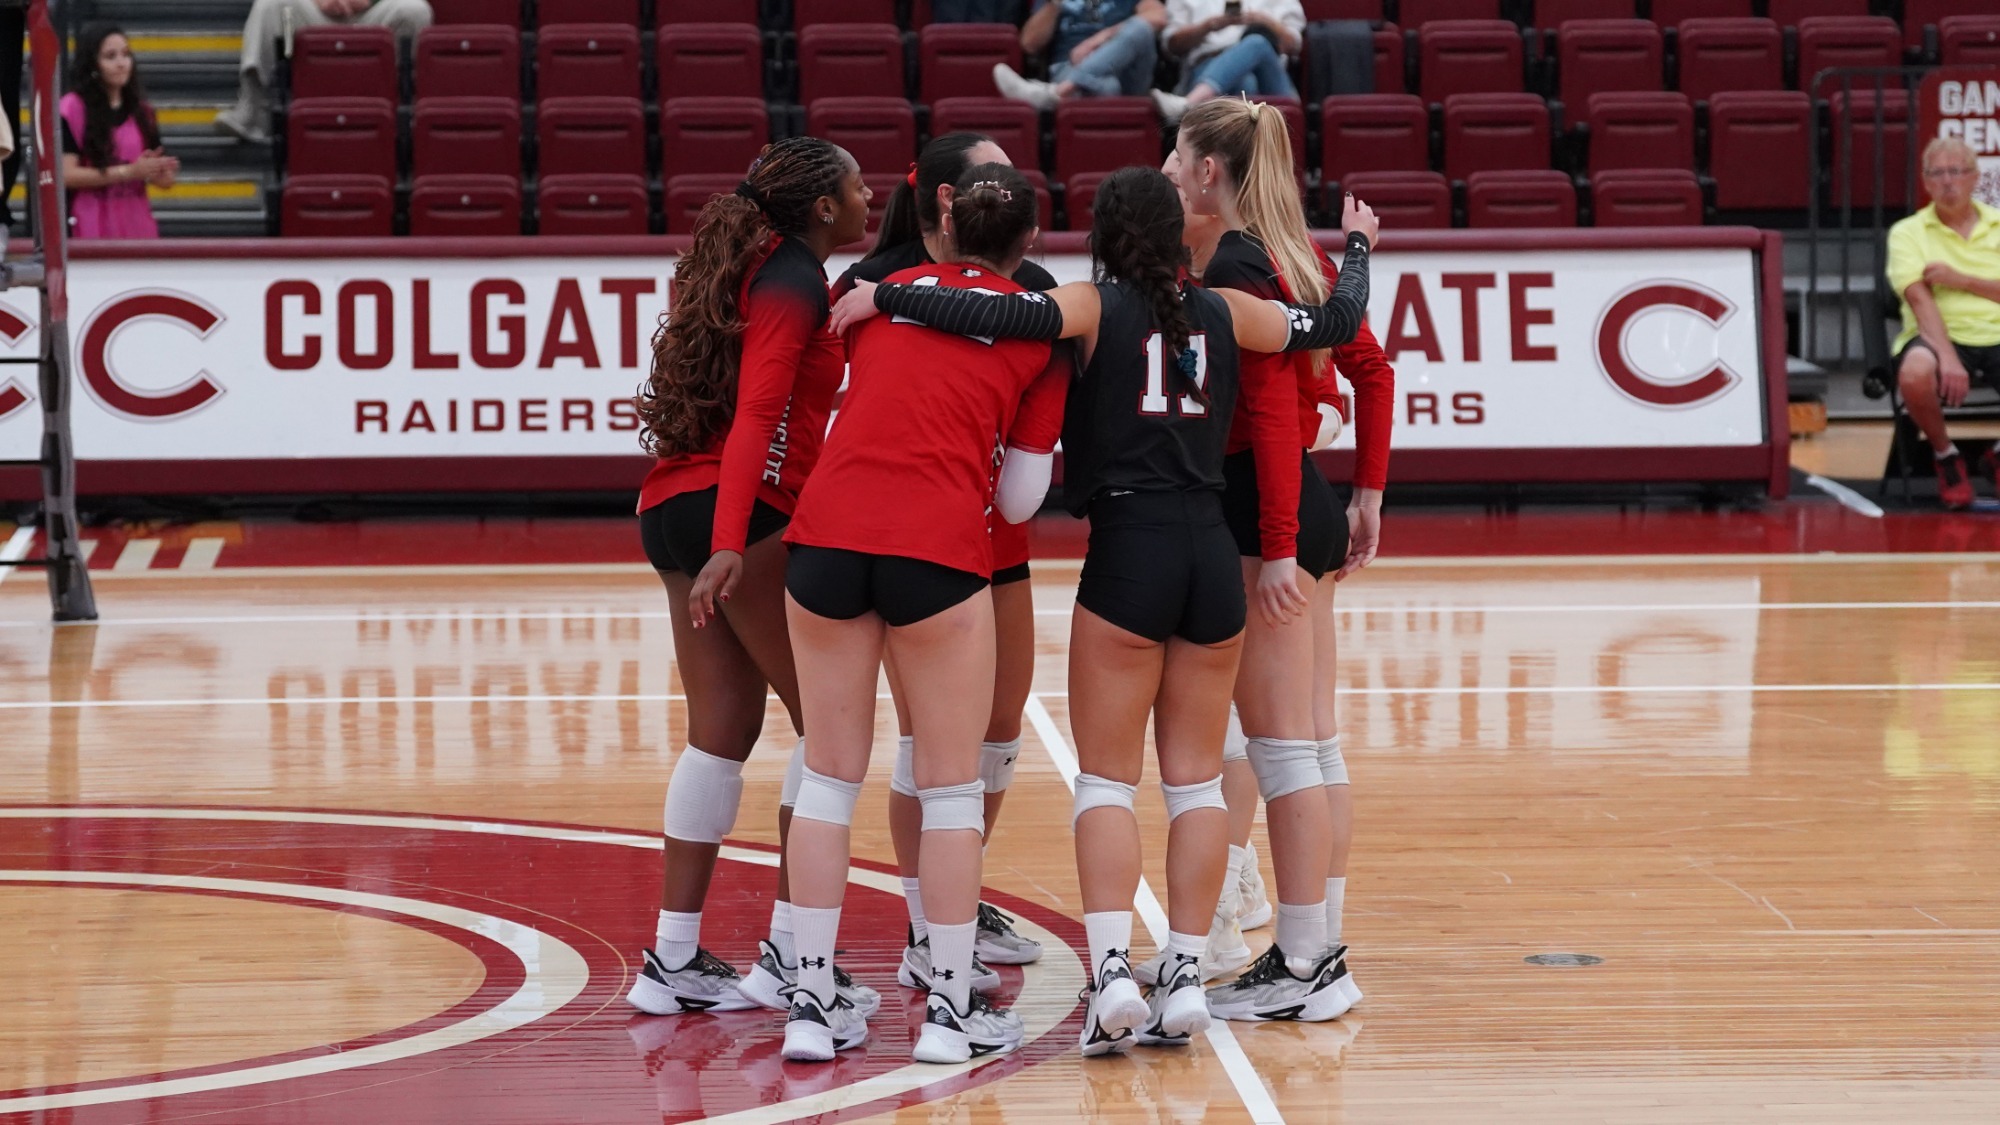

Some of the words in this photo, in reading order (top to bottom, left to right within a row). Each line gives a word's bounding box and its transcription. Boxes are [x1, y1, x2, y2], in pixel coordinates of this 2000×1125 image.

[76, 286, 226, 424] C
[265, 278, 675, 370] COLGAT
[1594, 278, 1741, 411] C
[355, 398, 640, 433] RAIDERS
